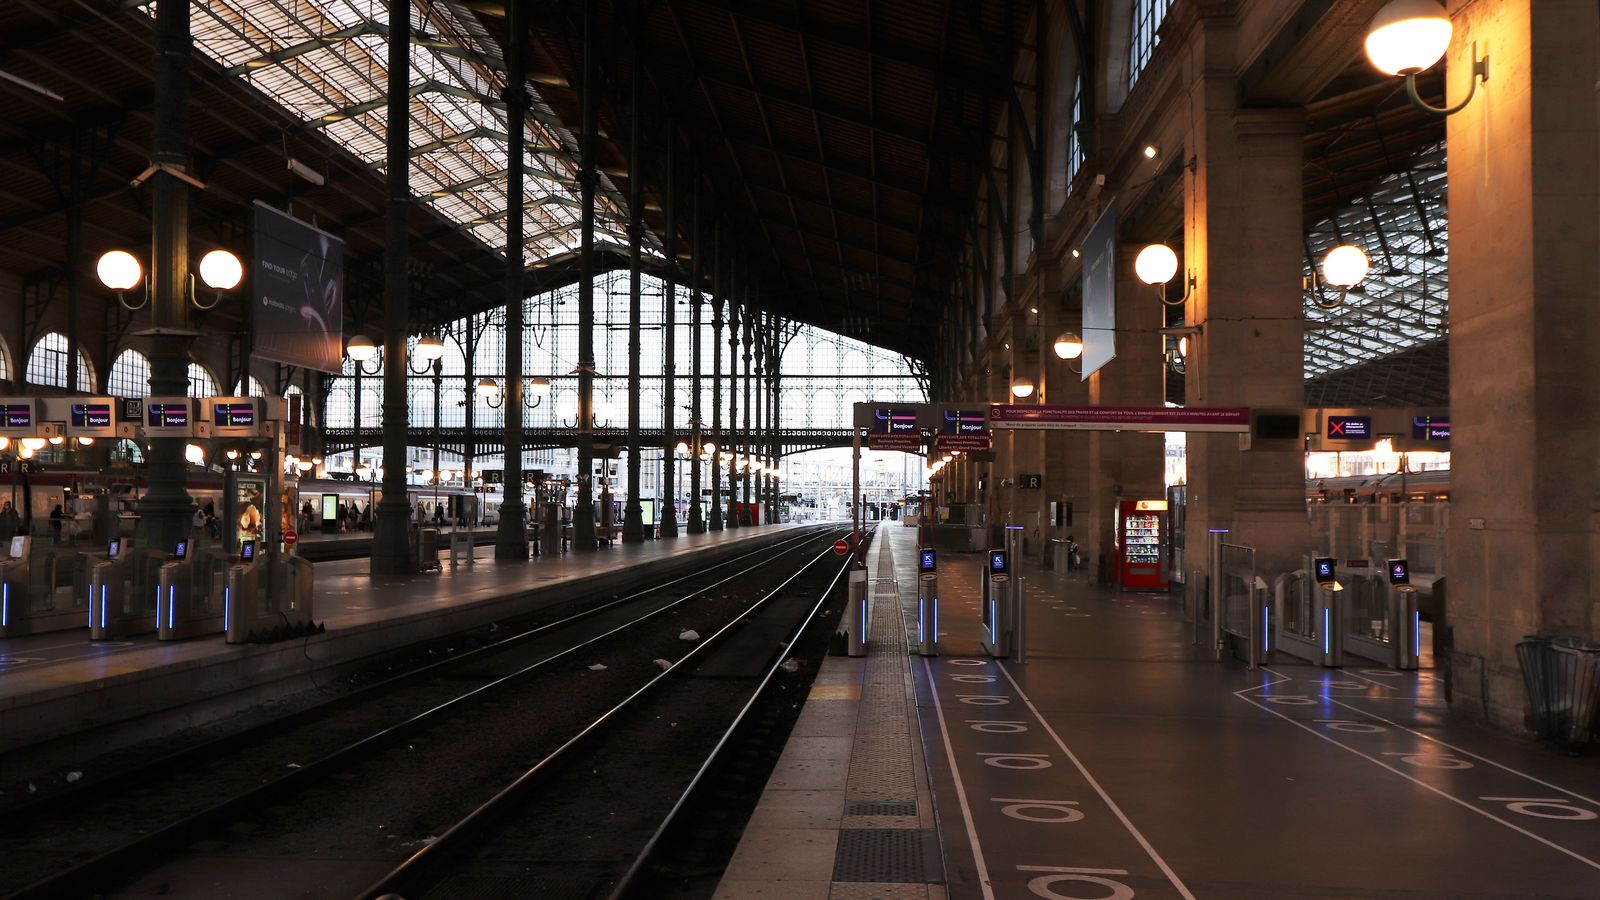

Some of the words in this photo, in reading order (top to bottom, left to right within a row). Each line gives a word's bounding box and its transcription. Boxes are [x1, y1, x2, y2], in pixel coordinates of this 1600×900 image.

[273, 264, 286, 275] YOUR
[1, 463, 8, 473] R
[21, 463, 29, 473] R
[492, 472, 499, 482] R
[527, 472, 534, 482] R
[1030, 477, 1038, 488] R
